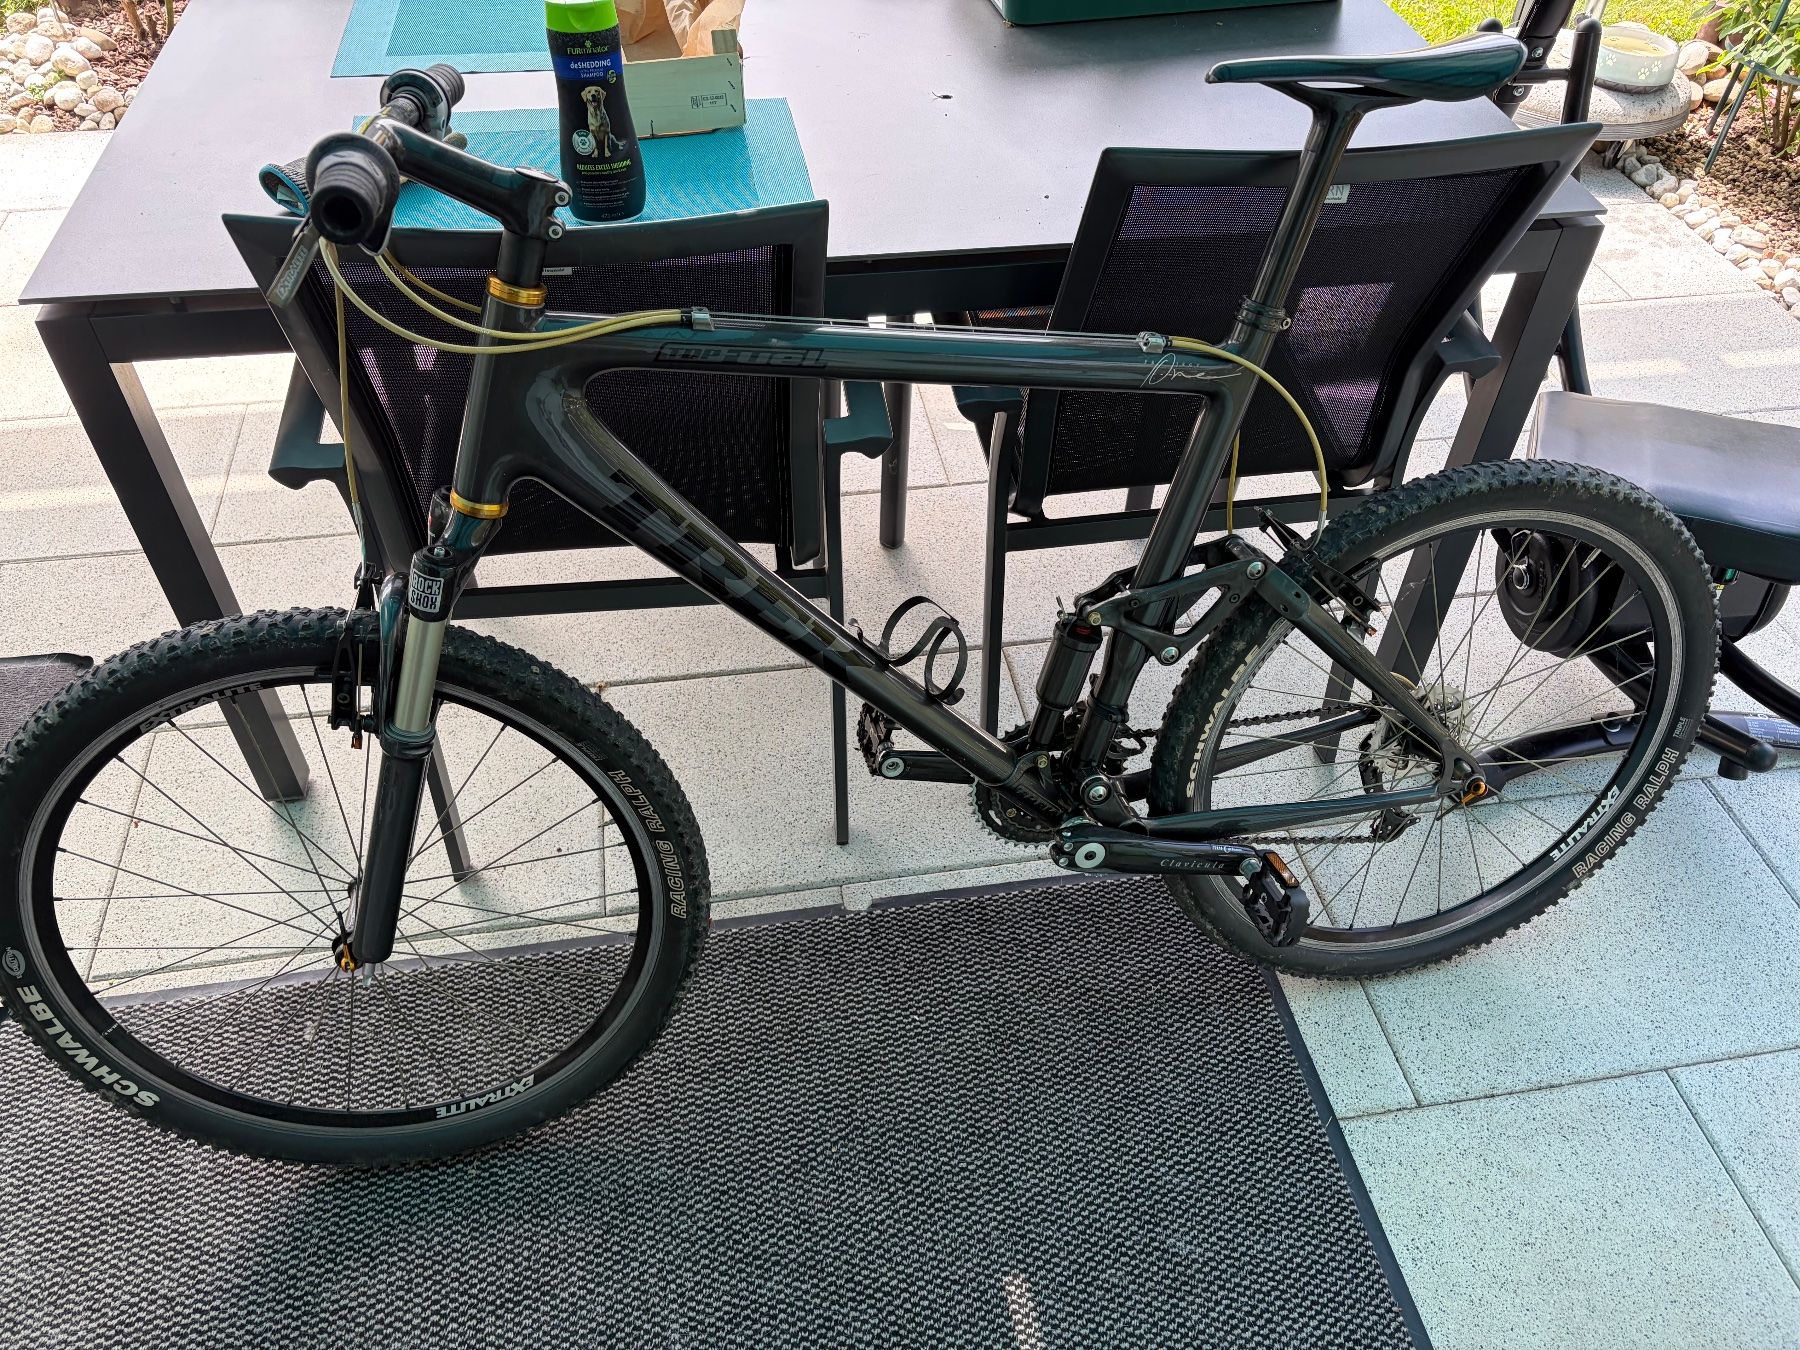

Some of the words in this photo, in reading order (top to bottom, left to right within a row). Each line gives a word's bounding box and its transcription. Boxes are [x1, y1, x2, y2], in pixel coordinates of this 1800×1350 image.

[570, 59, 612, 69] deSHEDDING
[410, 589, 438, 610] SHOX
[412, 573, 441, 595] ROCK
[140, 682, 263, 734] EXTRALITE
[608, 769, 666, 833] RALPH
[1549, 784, 1621, 862] EXTRALITE
[1572, 811, 1637, 879] RACING
[1633, 747, 1680, 811] RALPH
[655, 839, 688, 919] RACING
[1160, 859, 1225, 869] Clavicula
[16, 984, 161, 1107] SCHWALBE
[435, 1073, 535, 1119] EXTRALITE
